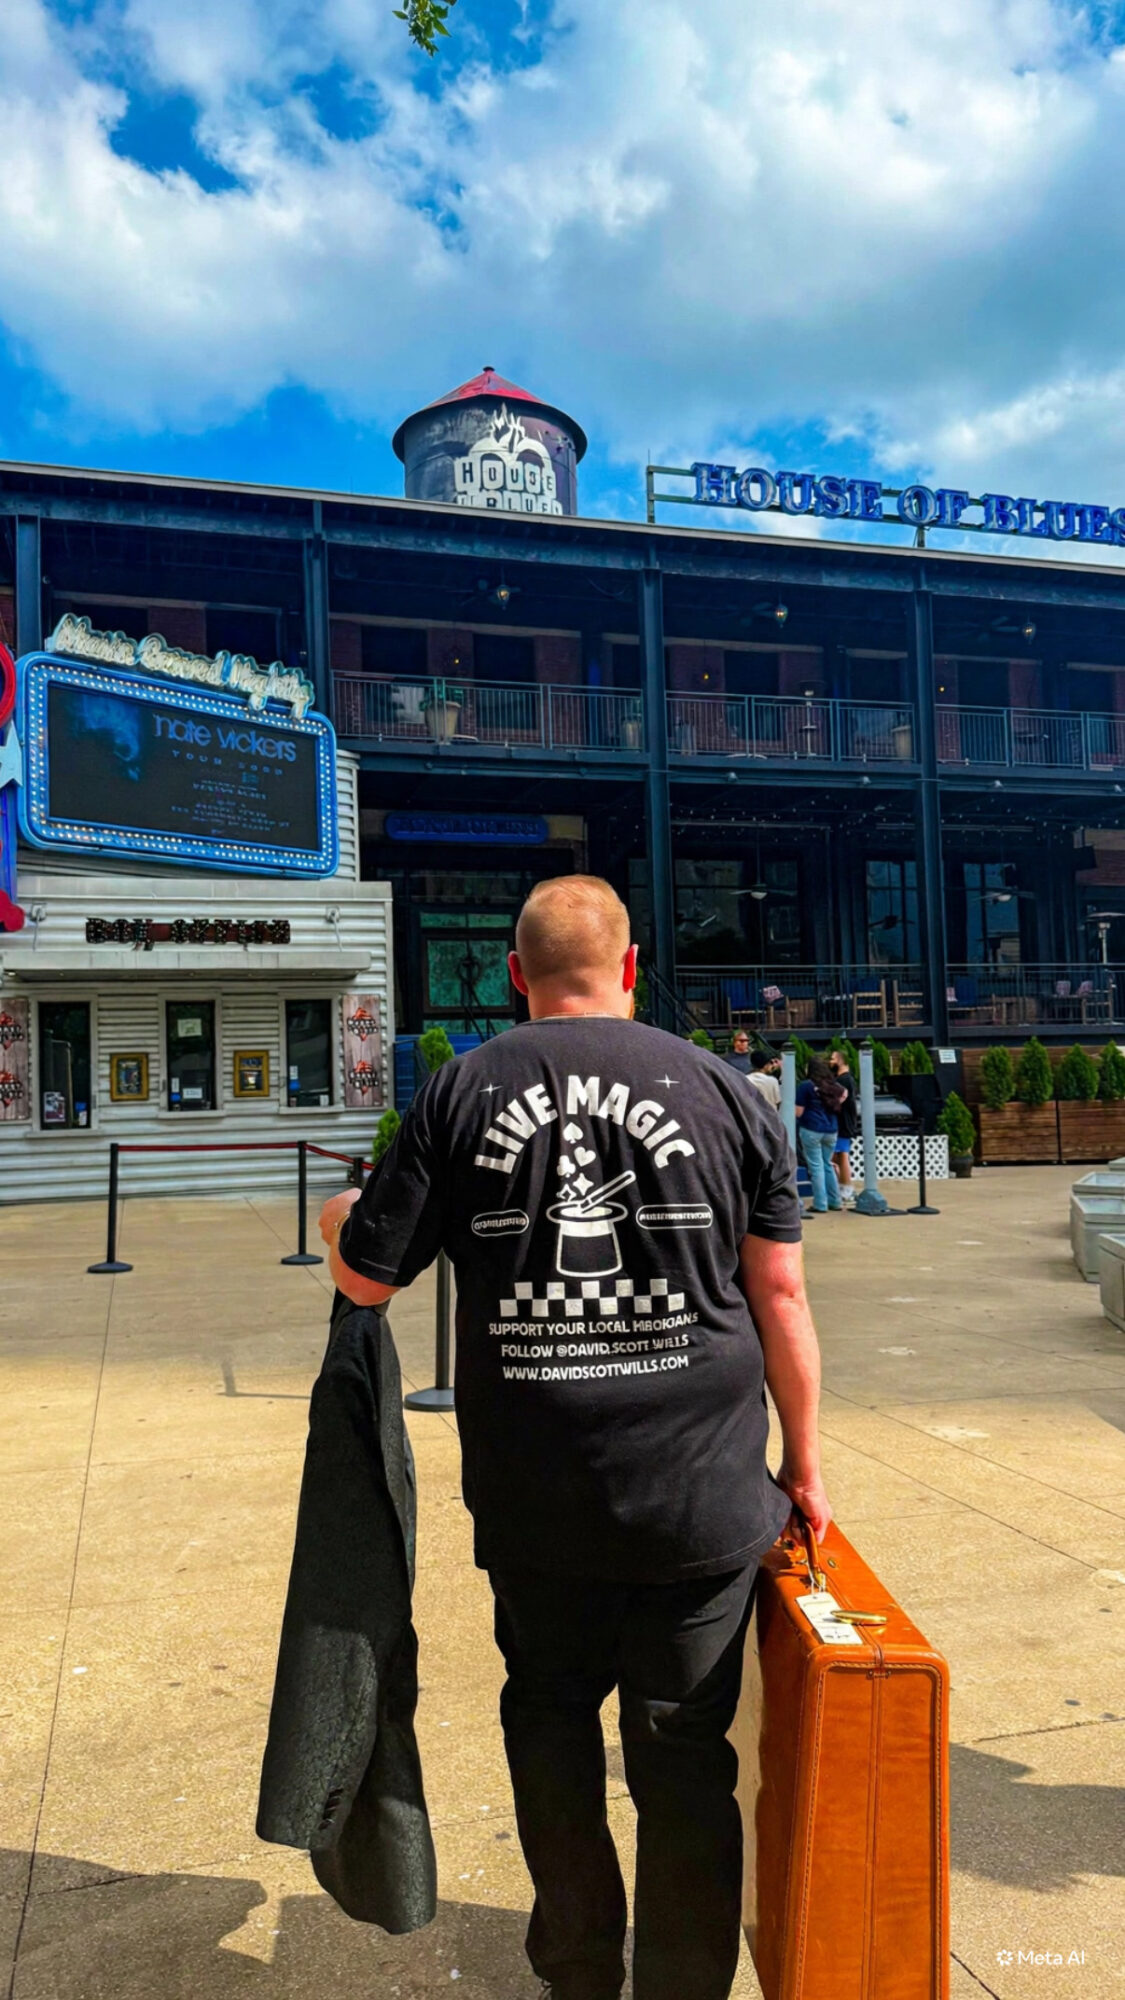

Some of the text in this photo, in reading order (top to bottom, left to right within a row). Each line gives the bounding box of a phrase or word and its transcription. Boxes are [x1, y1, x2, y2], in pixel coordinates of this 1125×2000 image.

[690, 462, 883, 519] HOUSE
[896, 485, 969, 527] OF
[474, 1074, 696, 1174] LIVE MAGIC
[488, 1322, 544, 1337] SUPPORT
[546, 1321, 586, 1336] YOUR
[588, 1320, 630, 1334] LOCAL
[501, 1344, 554, 1358] FOLLOW
[502, 1355, 690, 1381] WWW.DAVIDSCOTTWILLS.COM
